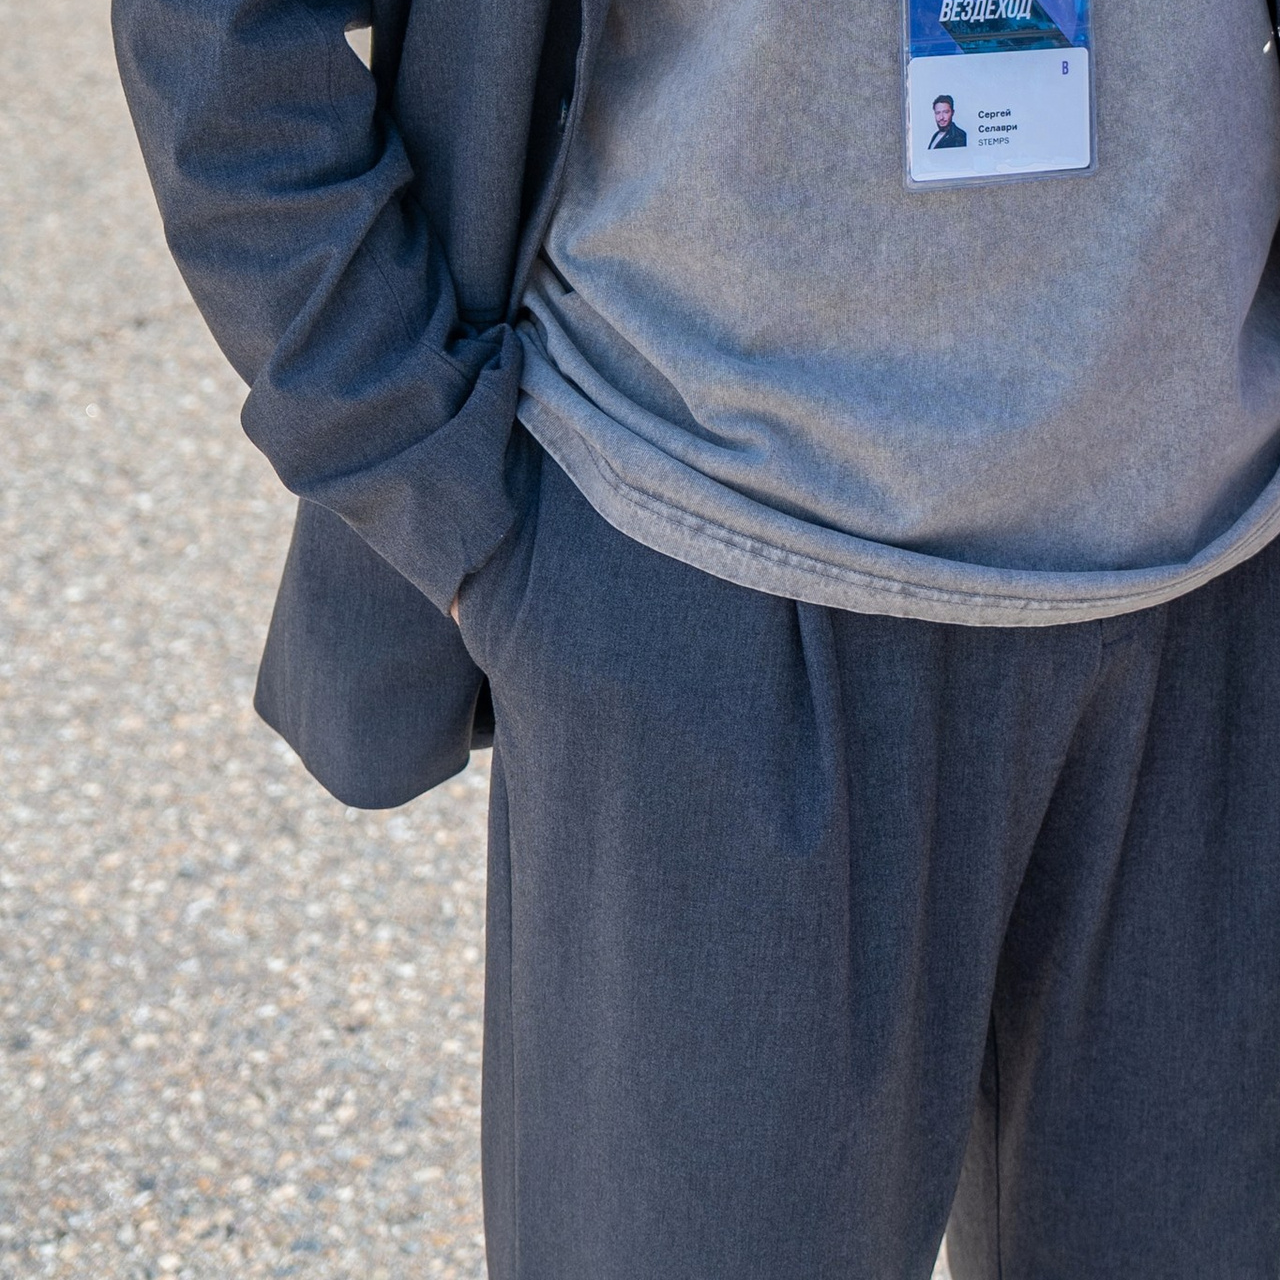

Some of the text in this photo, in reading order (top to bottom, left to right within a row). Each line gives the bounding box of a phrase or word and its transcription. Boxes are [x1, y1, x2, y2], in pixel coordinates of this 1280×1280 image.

[978, 109, 1011, 119] Сергей
[978, 124, 1018, 133] Селаври
[978, 137, 1010, 146] STEMPS
